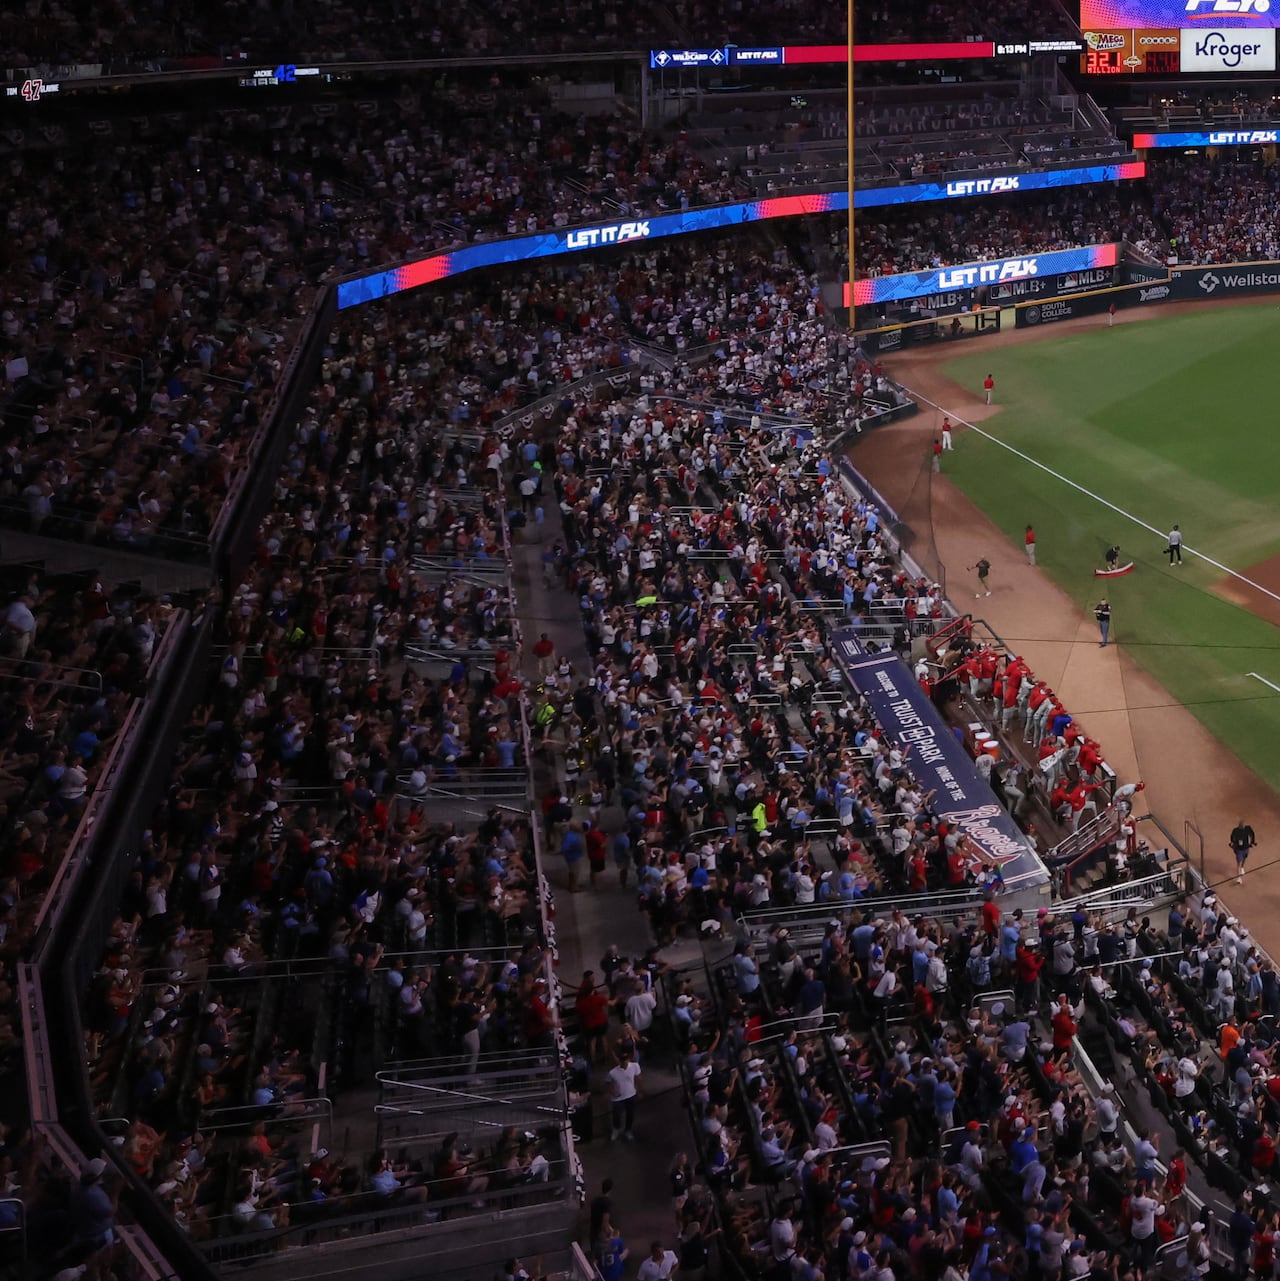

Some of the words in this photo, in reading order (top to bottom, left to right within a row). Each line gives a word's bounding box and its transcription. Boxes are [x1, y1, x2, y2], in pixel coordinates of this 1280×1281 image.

[1098, 34, 1124, 43] MEGA
[1195, 32, 1261, 67] Kroger
[1087, 52, 1121, 67] 321
[274, 64, 297, 82] 42
[21, 79, 43, 101] 47
[1209, 132, 1236, 143] LET
[1236, 132, 1251, 143] IT
[947, 180, 974, 196] LET
[976, 179, 991, 193] IT
[567, 229, 600, 248] LET
[601, 227, 619, 242] IT
[939, 267, 977, 288] LET
[980, 265, 1000, 283] IT
[1078, 269, 1111, 286] MLB+
[1012, 279, 1047, 296] MLB+
[928, 294, 964, 310] MLB+
[1042, 302, 1066, 311] SOUTH
[1042, 307, 1072, 319] COLLEGE
[890, 699, 923, 729] TRUIST
[914, 736, 946, 764] PARK
[938, 805, 1027, 856] Braves
